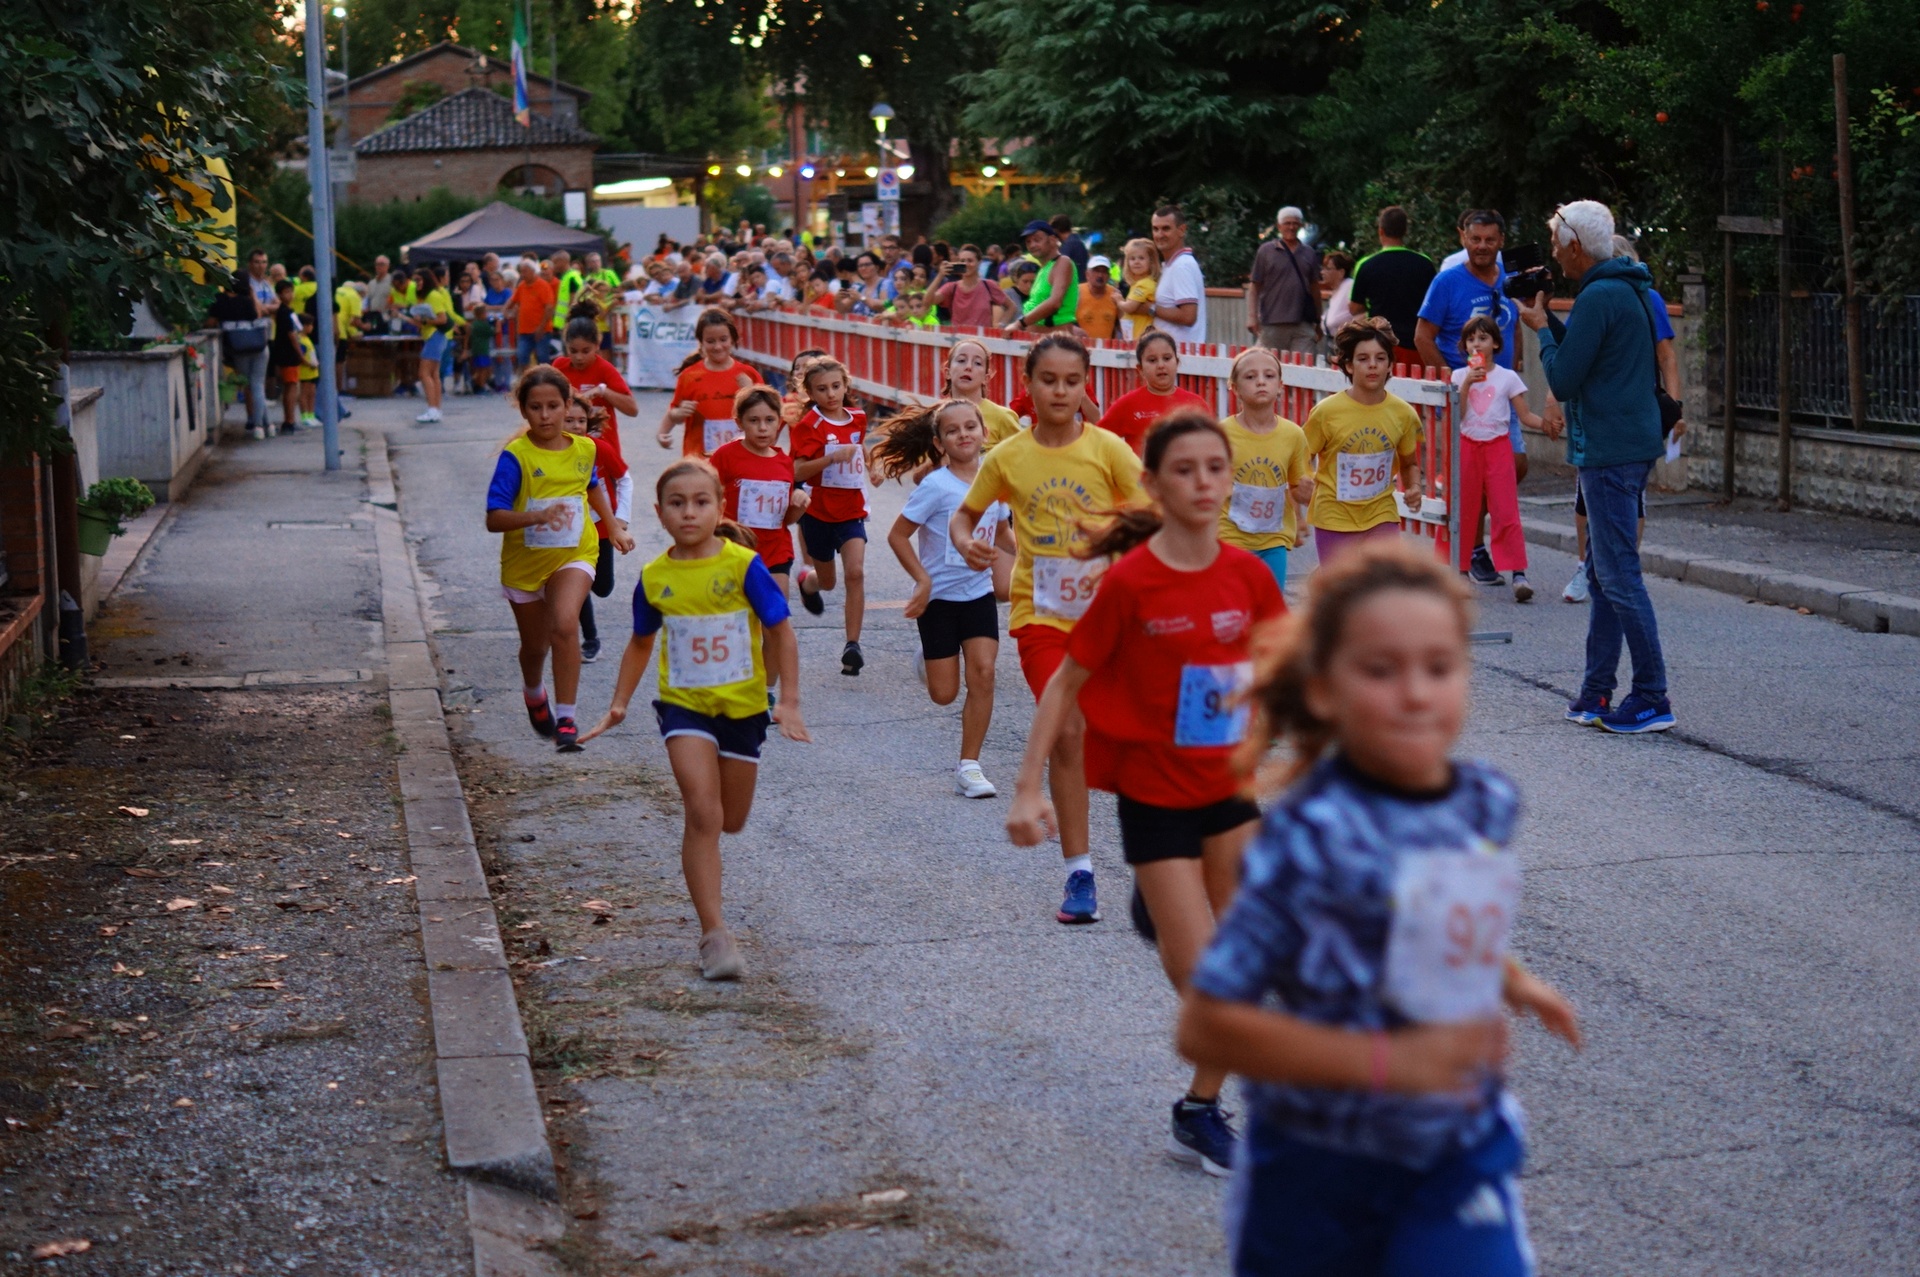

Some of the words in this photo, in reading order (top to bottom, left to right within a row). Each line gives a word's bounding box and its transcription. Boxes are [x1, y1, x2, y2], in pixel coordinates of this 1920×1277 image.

[1350, 464, 1385, 486] 526
[755, 494, 783, 514] 111
[1249, 501, 1275, 519] 58
[1060, 577, 1094, 602] 59
[692, 635, 729, 664] 55
[1203, 690, 1224, 721] 9
[1445, 902, 1506, 969] 92
